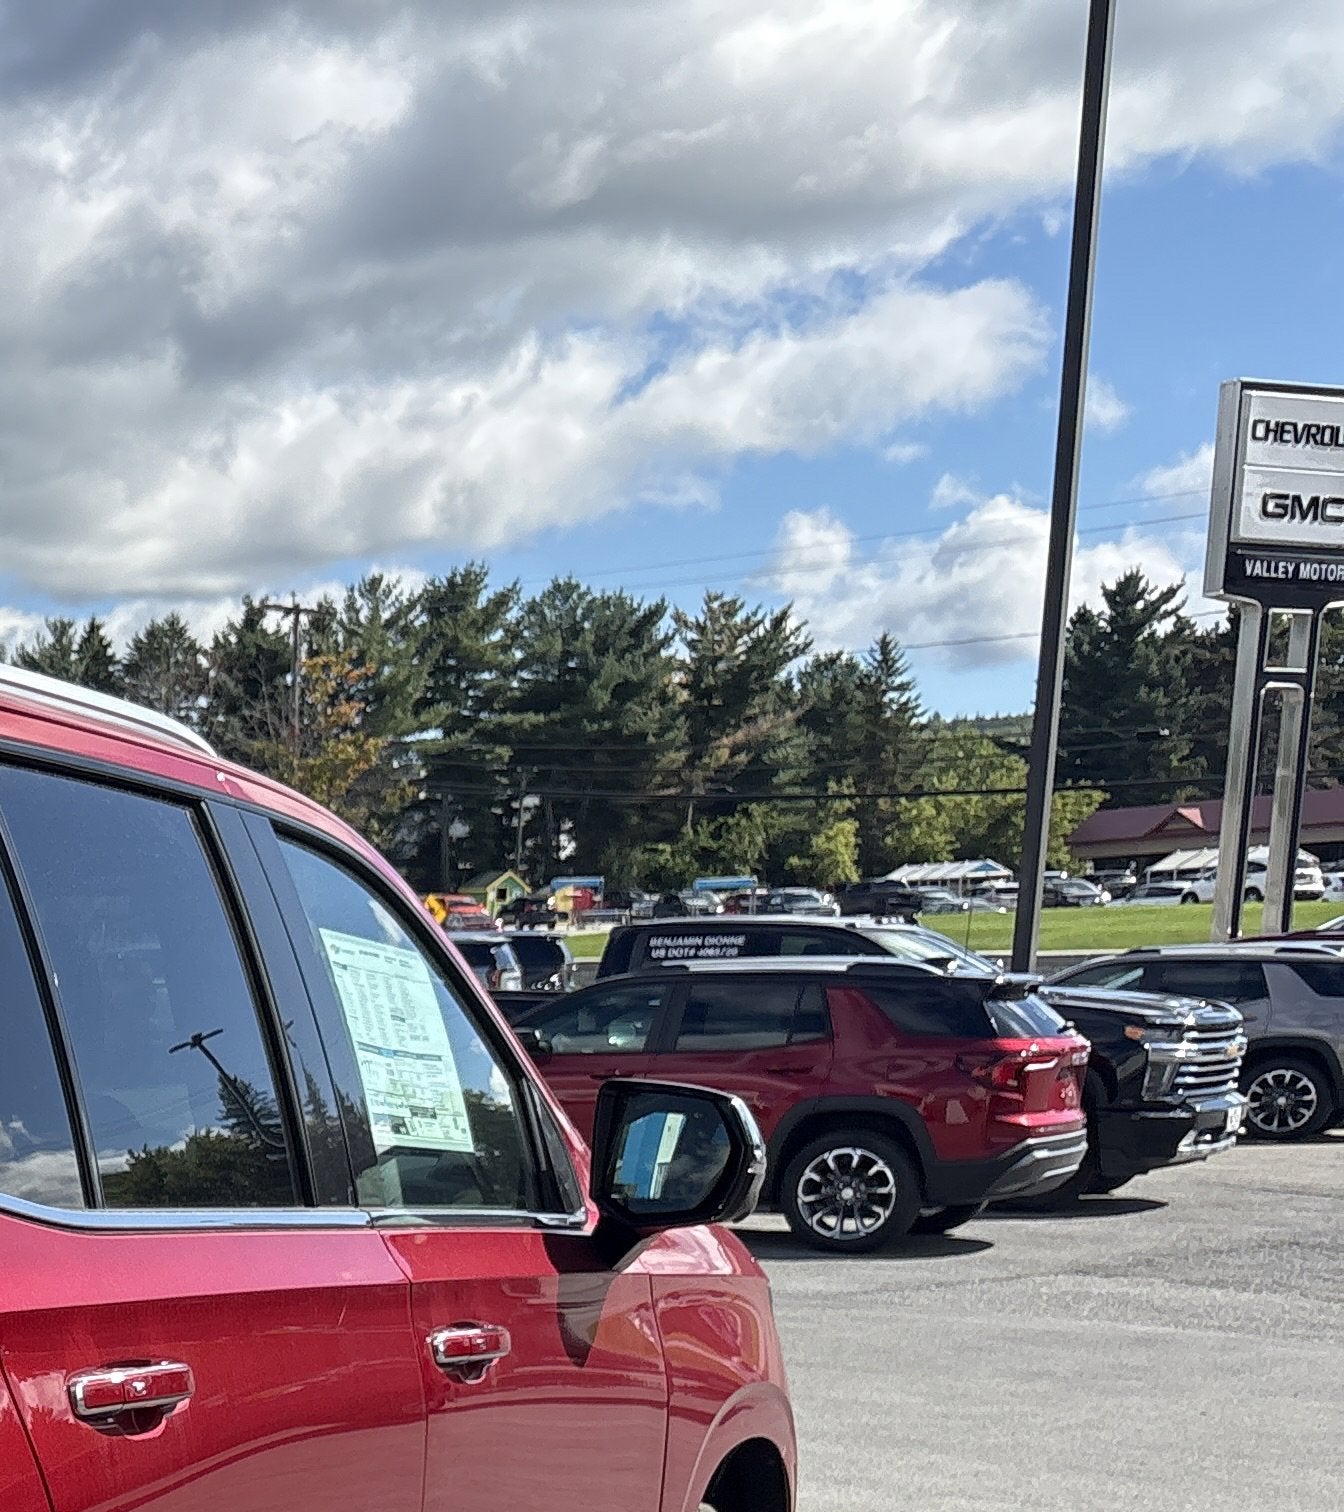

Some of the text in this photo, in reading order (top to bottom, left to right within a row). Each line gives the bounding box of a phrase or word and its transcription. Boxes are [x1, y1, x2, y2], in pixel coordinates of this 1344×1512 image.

[1251, 418, 1343, 447] CHEVROL
[1261, 491, 1343, 523] GMC
[1245, 558, 1296, 579] VALLEY
[650, 935, 703, 948] BENJAMIN
